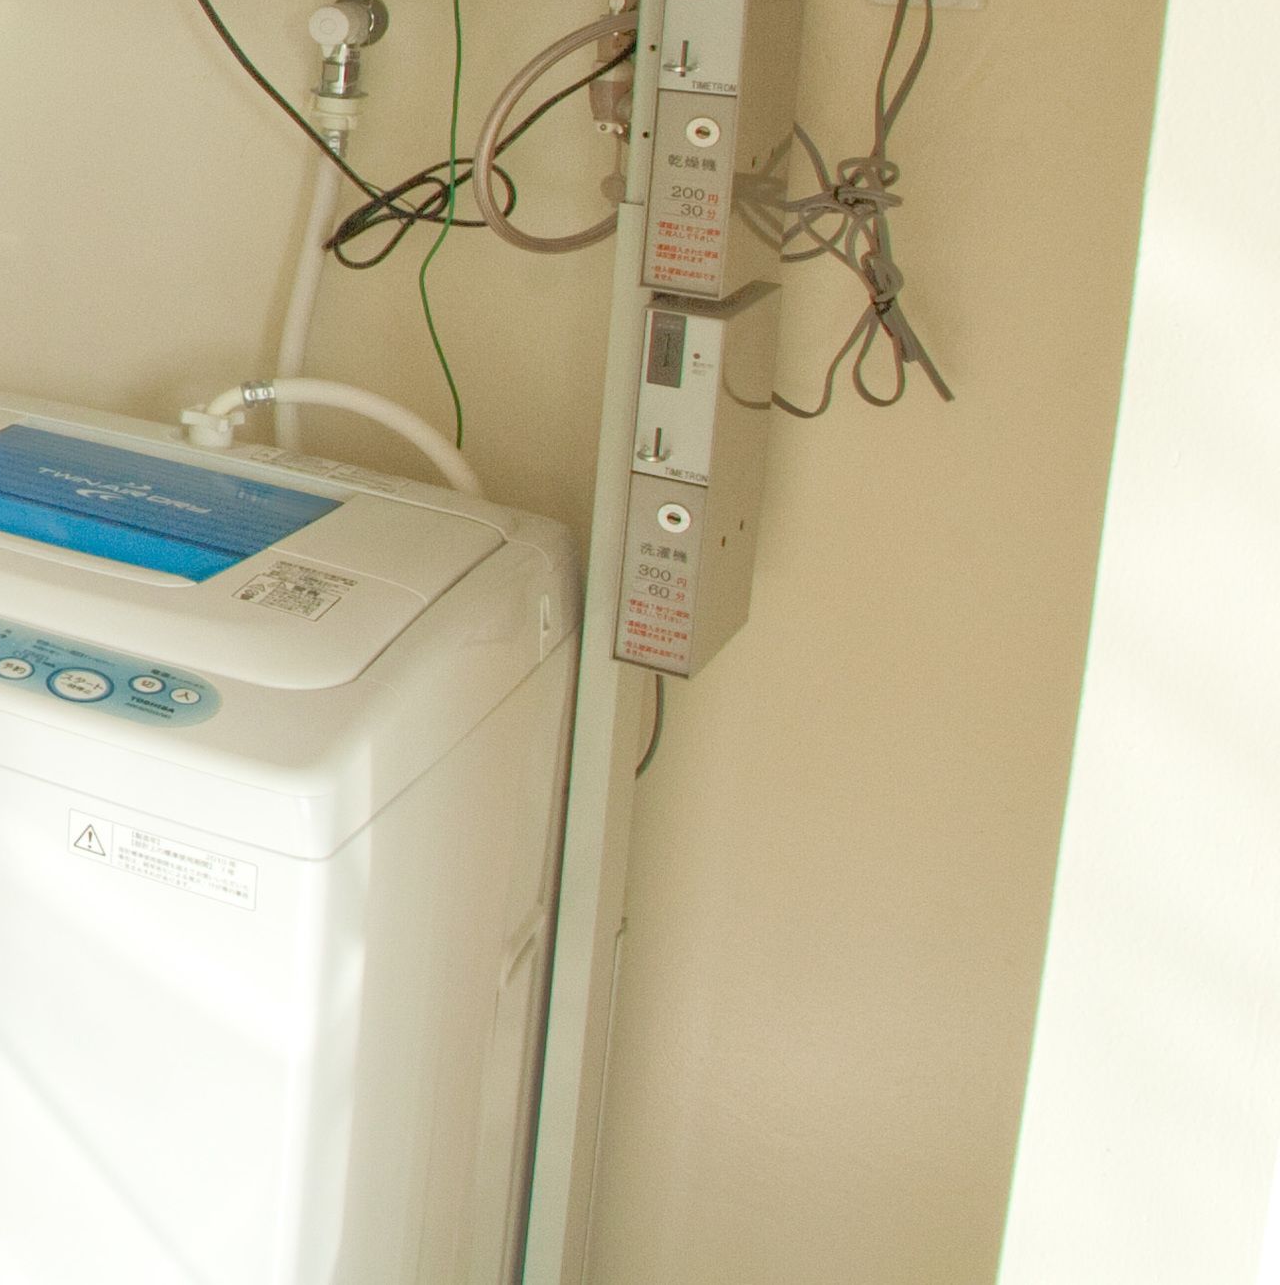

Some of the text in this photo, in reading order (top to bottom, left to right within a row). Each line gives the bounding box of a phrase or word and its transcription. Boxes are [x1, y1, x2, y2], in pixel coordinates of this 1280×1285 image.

[668, 154, 717, 172] 乾燥機
[671, 185, 705, 201] 200
[680, 203, 703, 217] 30
[638, 563, 672, 582] 300
[648, 583, 670, 599] 60
